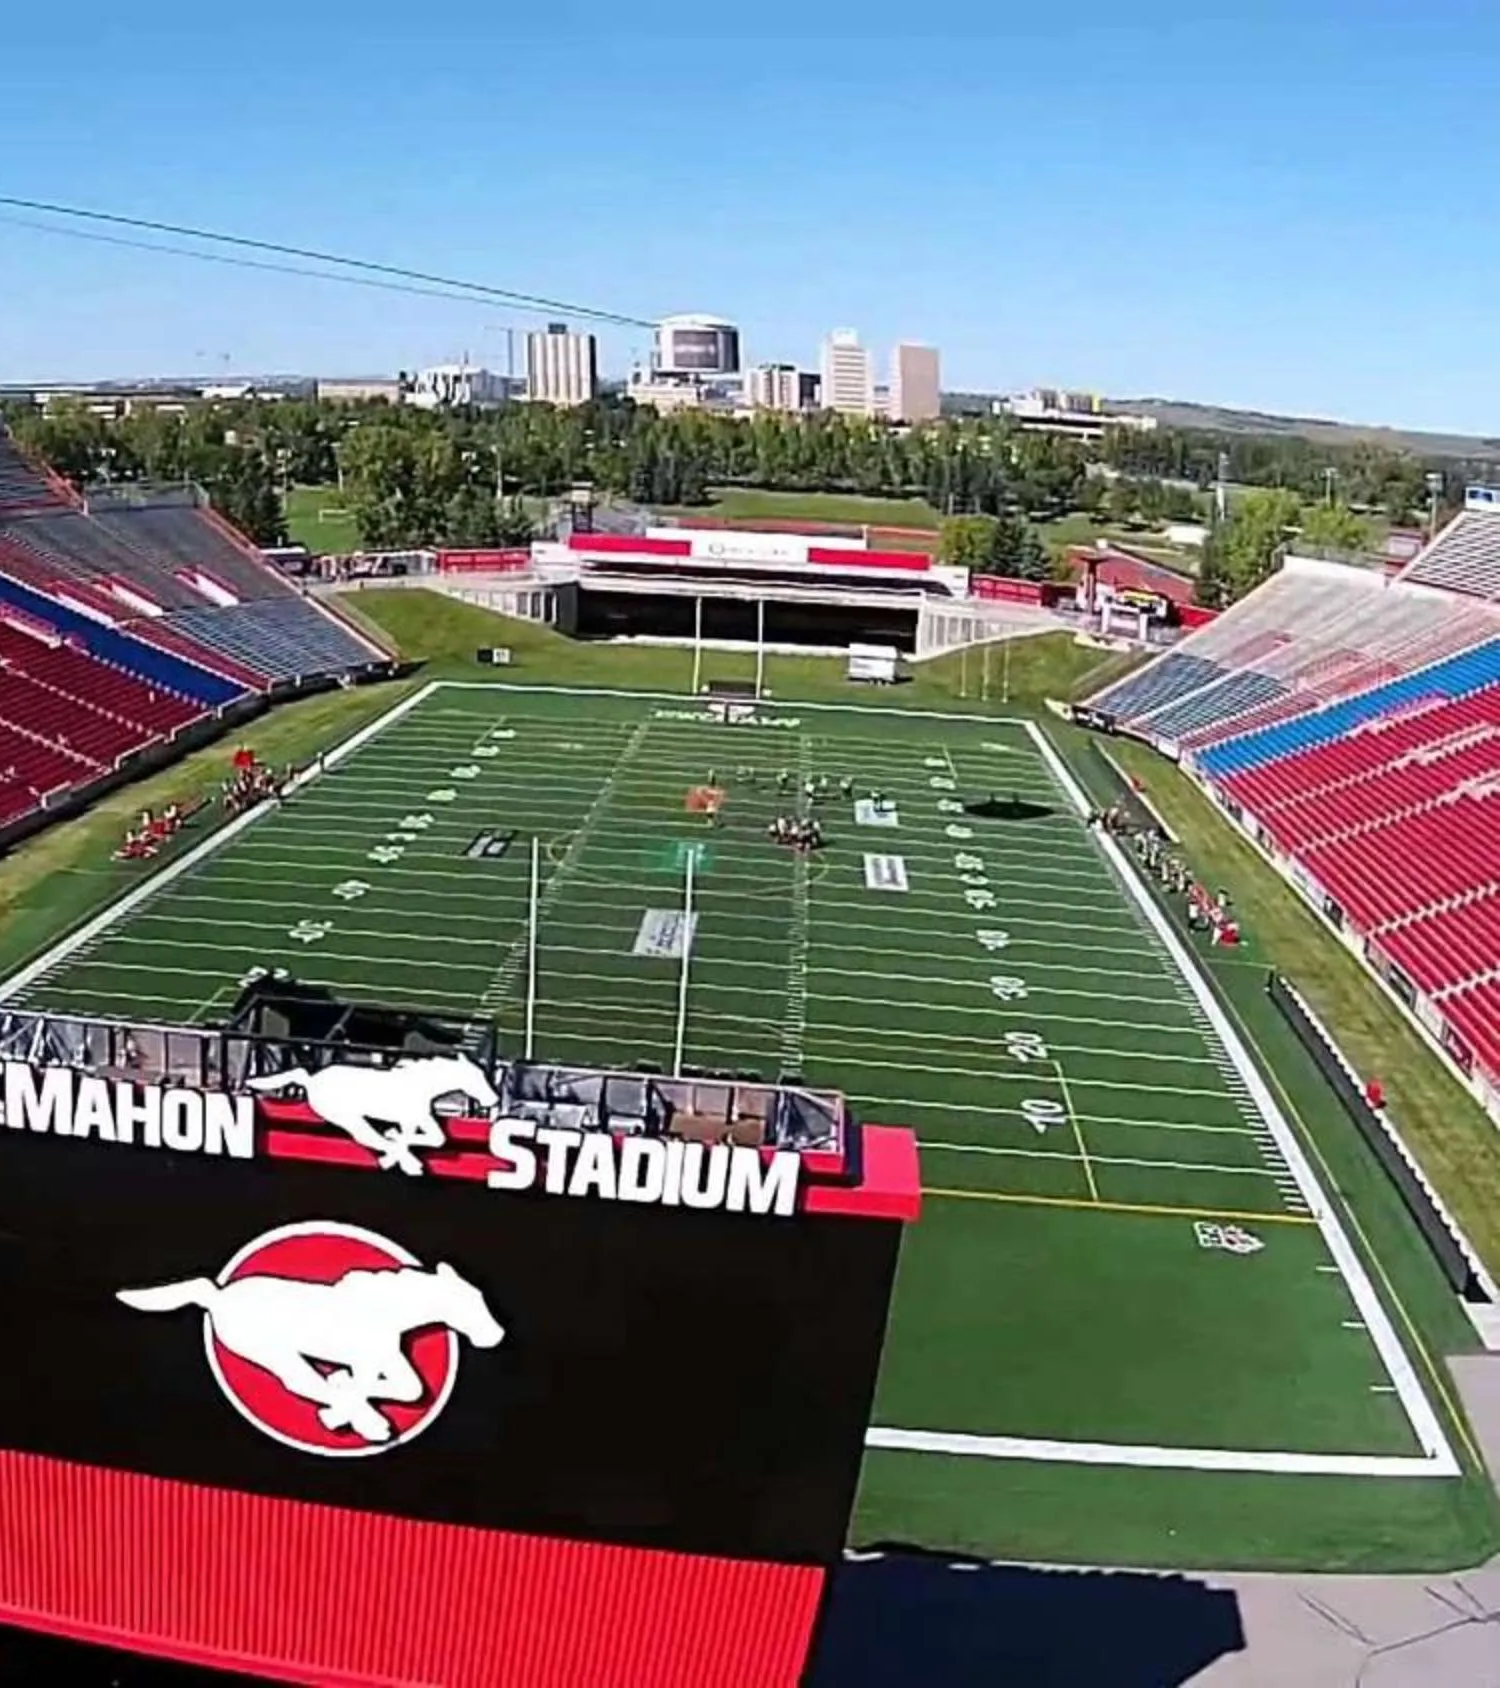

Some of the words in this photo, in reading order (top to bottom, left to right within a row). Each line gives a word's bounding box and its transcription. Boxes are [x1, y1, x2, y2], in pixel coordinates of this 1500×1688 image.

[1003, 1031, 1048, 1062] 20
[1019, 1098, 1067, 1134] 10
[487, 1117, 801, 1217] STADIUM
